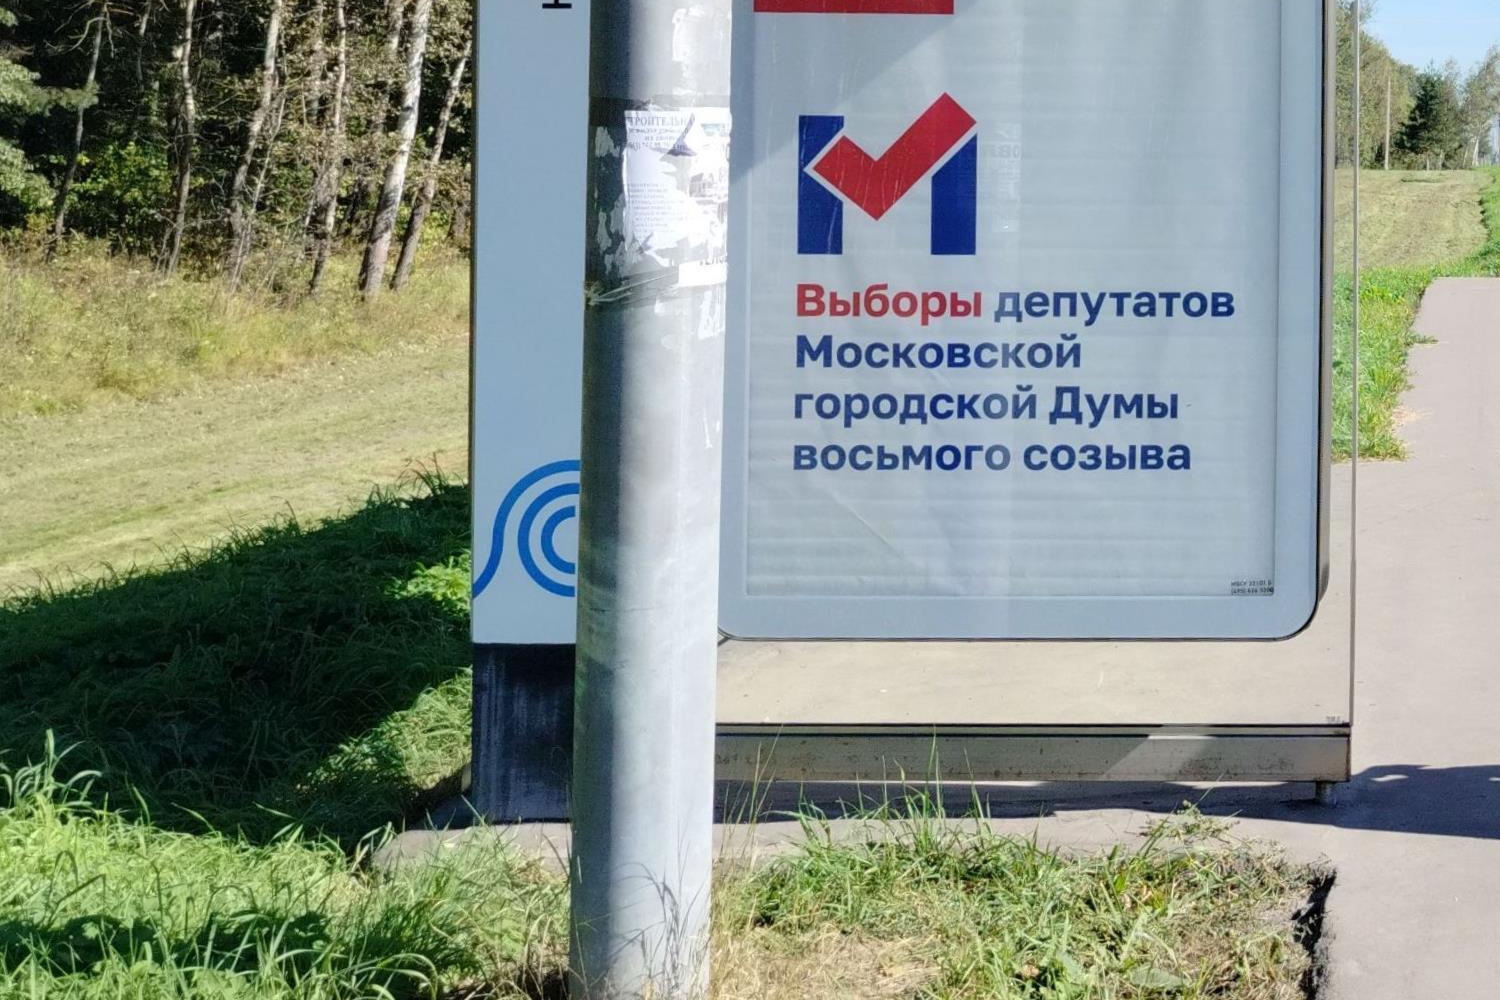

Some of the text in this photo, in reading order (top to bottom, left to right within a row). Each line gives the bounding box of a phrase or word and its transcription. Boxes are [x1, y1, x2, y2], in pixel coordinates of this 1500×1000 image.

[796, 282, 1235, 326] Выборы депутатов
[796, 332, 1082, 369] Московской
[793, 383, 1180, 428] городской Думы
[792, 443, 1192, 471] восьмого созыва
